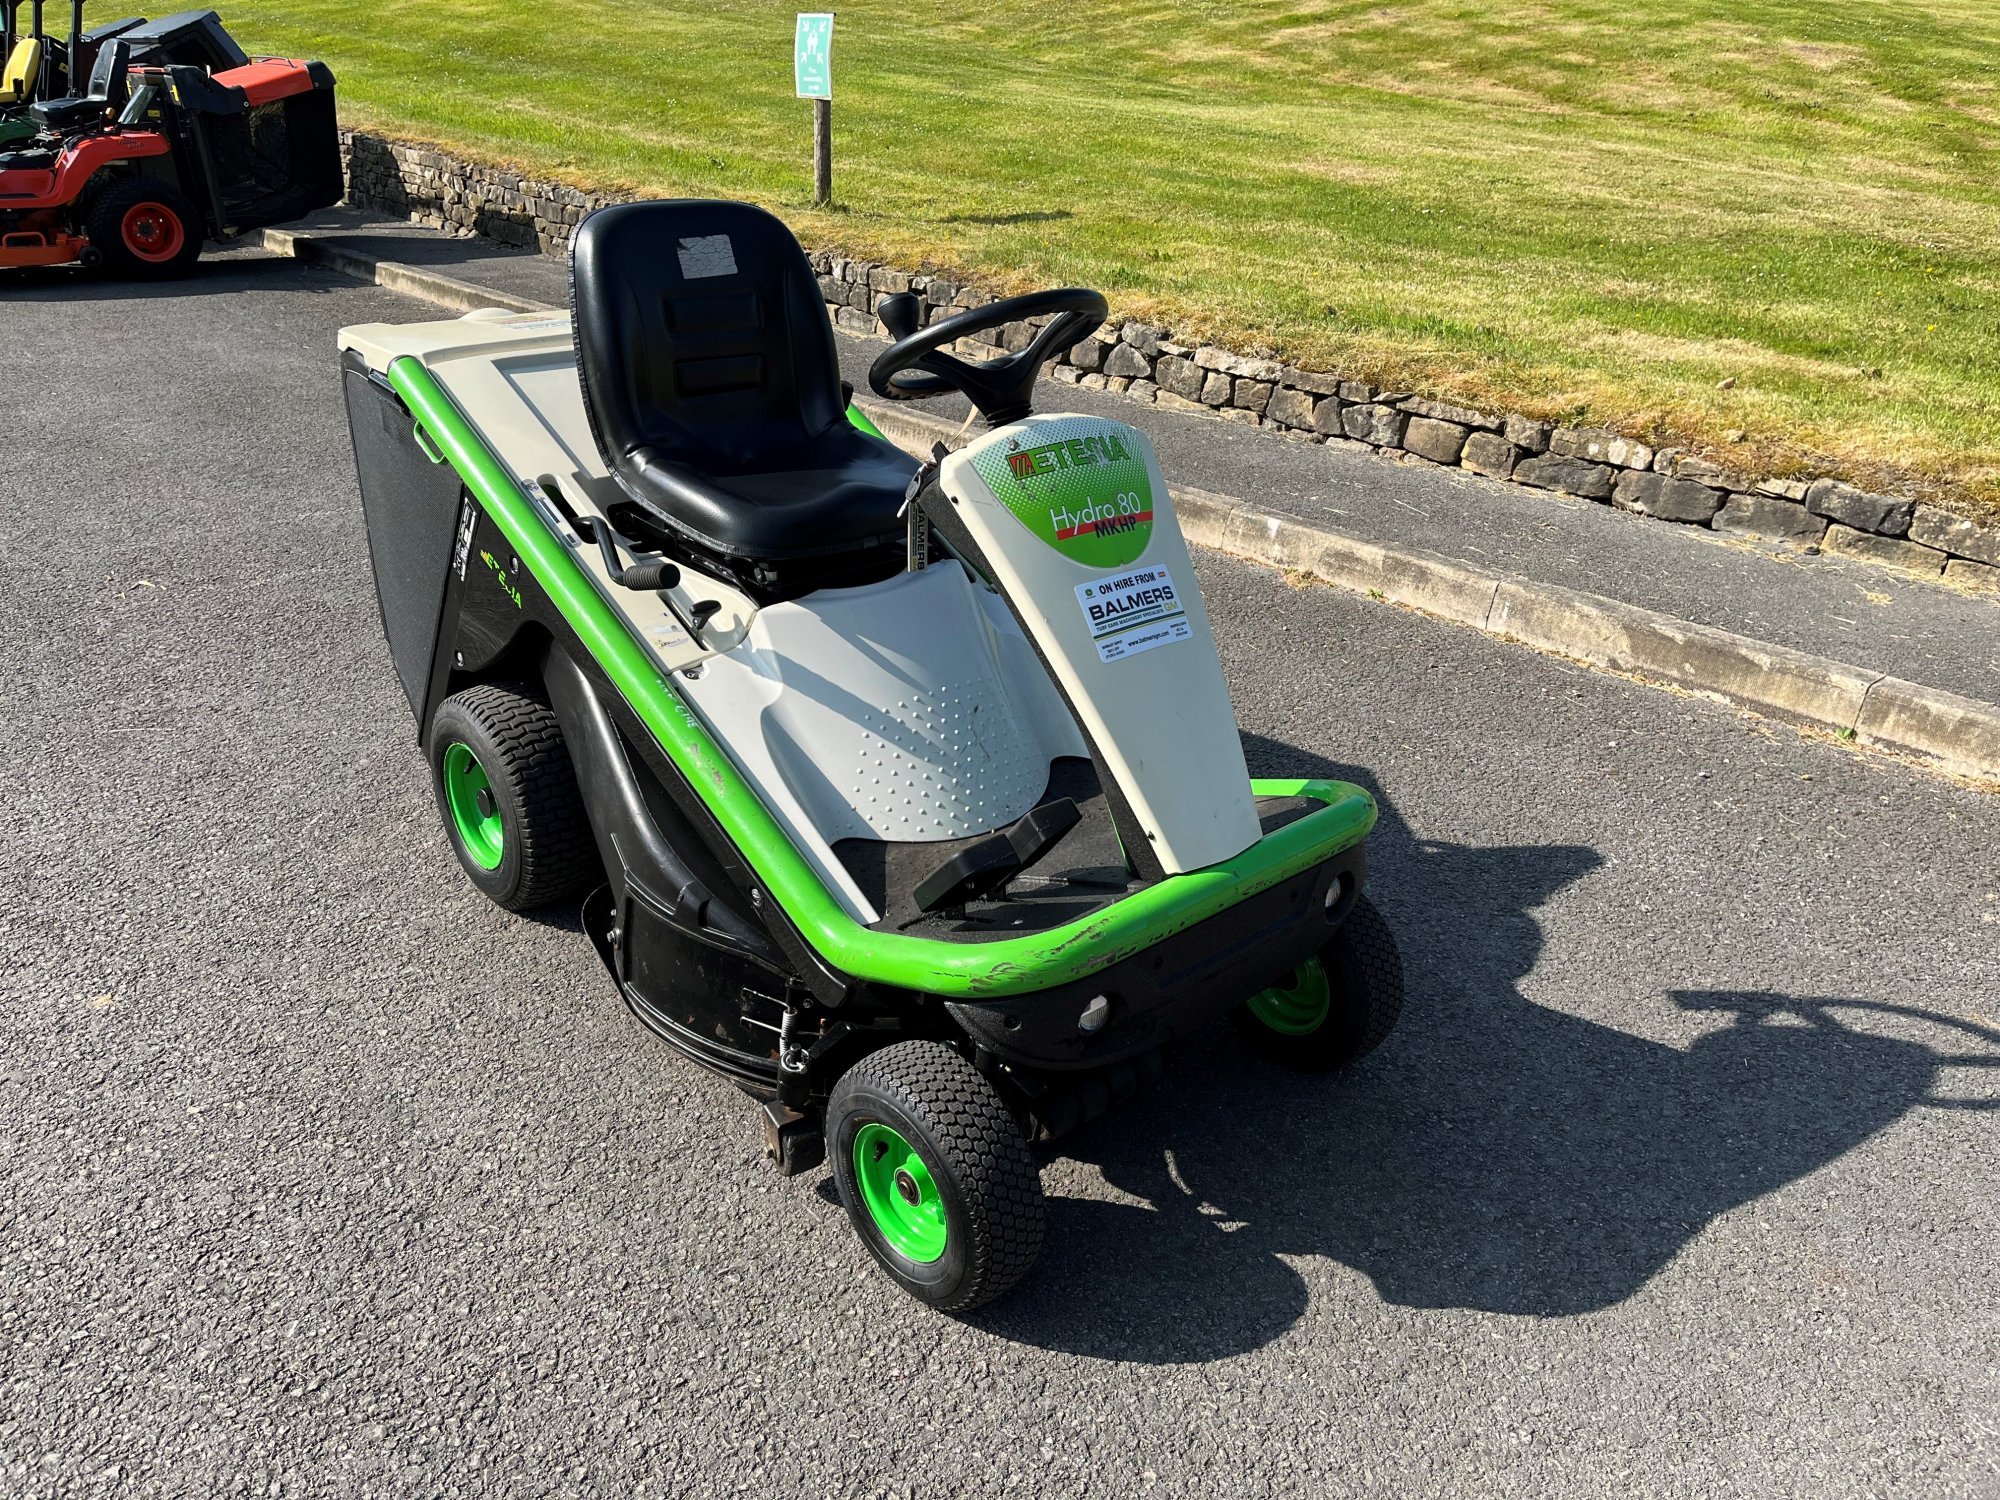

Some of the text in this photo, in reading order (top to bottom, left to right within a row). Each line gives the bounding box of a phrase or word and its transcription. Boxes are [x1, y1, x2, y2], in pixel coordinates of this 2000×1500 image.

[1025, 435, 1130, 477] ETESIA
[1050, 492, 1141, 535] Hydro 80
[1094, 516, 1136, 538] MKHP
[1099, 572, 1156, 595] ON HIRE FROM
[1088, 585, 1174, 621] BALMERS
[1163, 601, 1178, 612] GM
